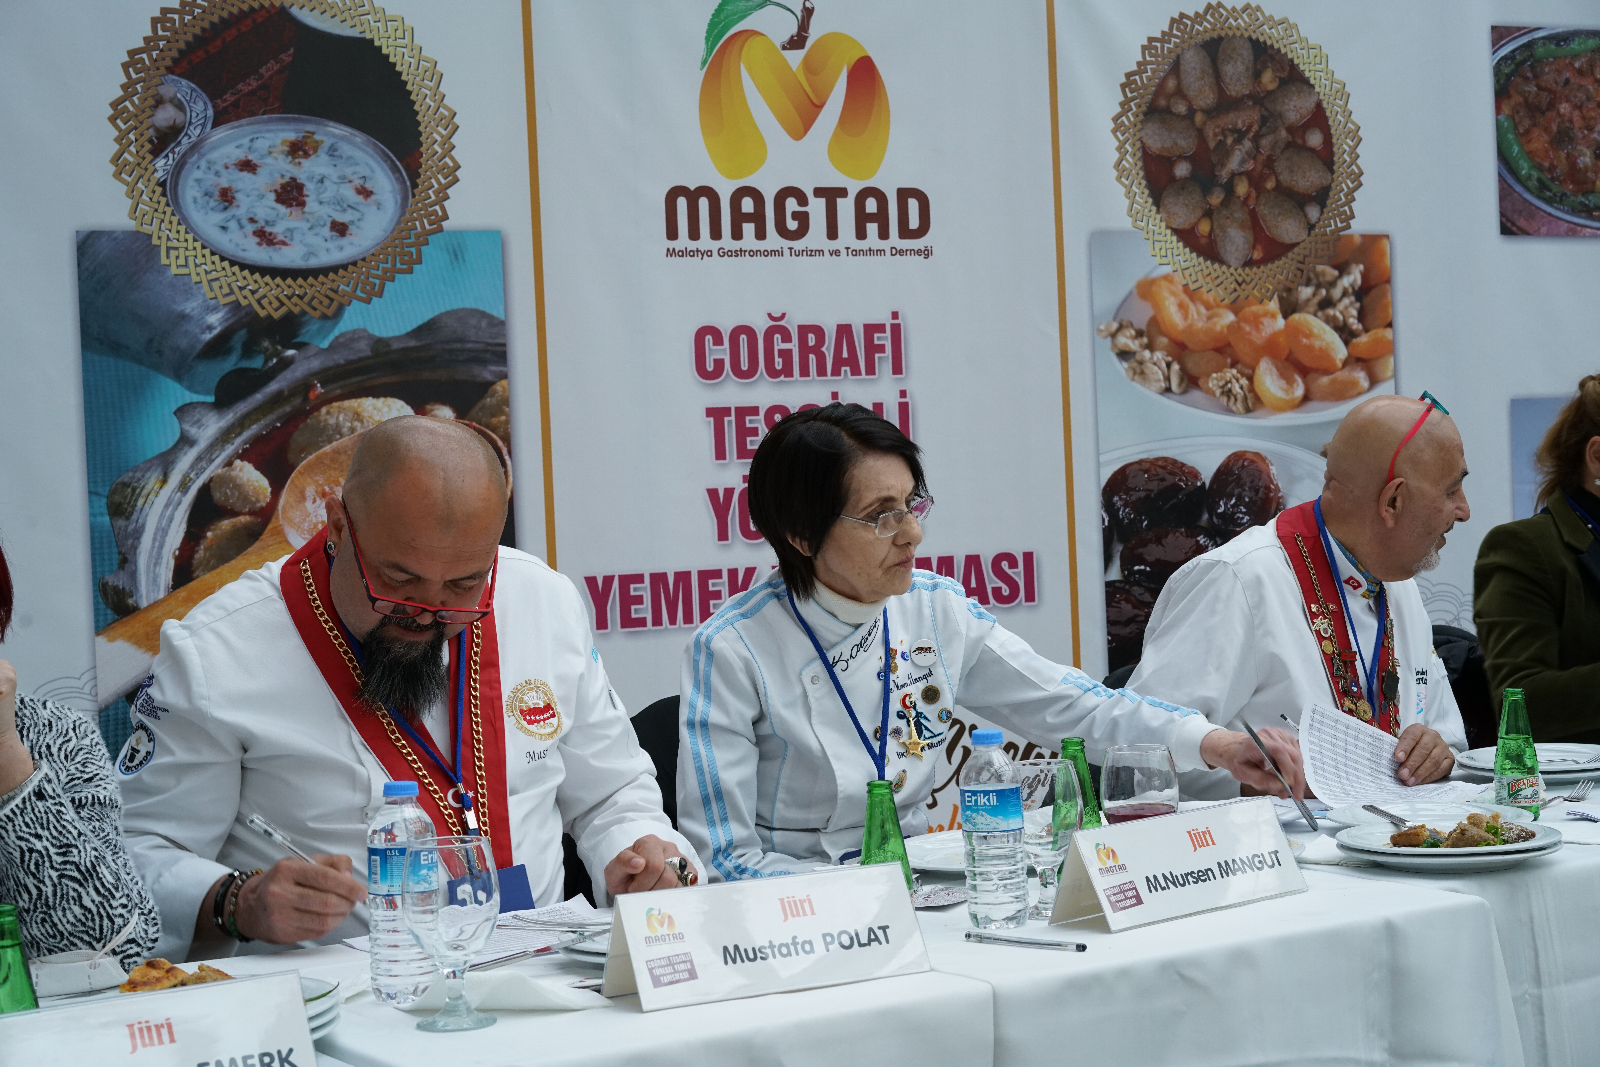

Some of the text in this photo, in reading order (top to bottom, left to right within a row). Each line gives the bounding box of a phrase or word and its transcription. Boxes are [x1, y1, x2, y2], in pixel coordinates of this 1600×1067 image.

[664, 185, 931, 241] MAGTAD
[665, 246, 933, 260] Malatya Gastronomi Turizm ve Tanıtım Derneği
[693, 310, 904, 382] COĞRAFİ
[964, 792, 997, 806] Erikli
[1186, 826, 1217, 852] Jüri
[1145, 850, 1282, 893] M.Nursen MANGUT
[778, 894, 817, 922] Jüri
[644, 932, 685, 945] MAGTAD
[722, 924, 890, 966] Mustafa POLAT
[126, 1018, 176, 1054] Jüri
